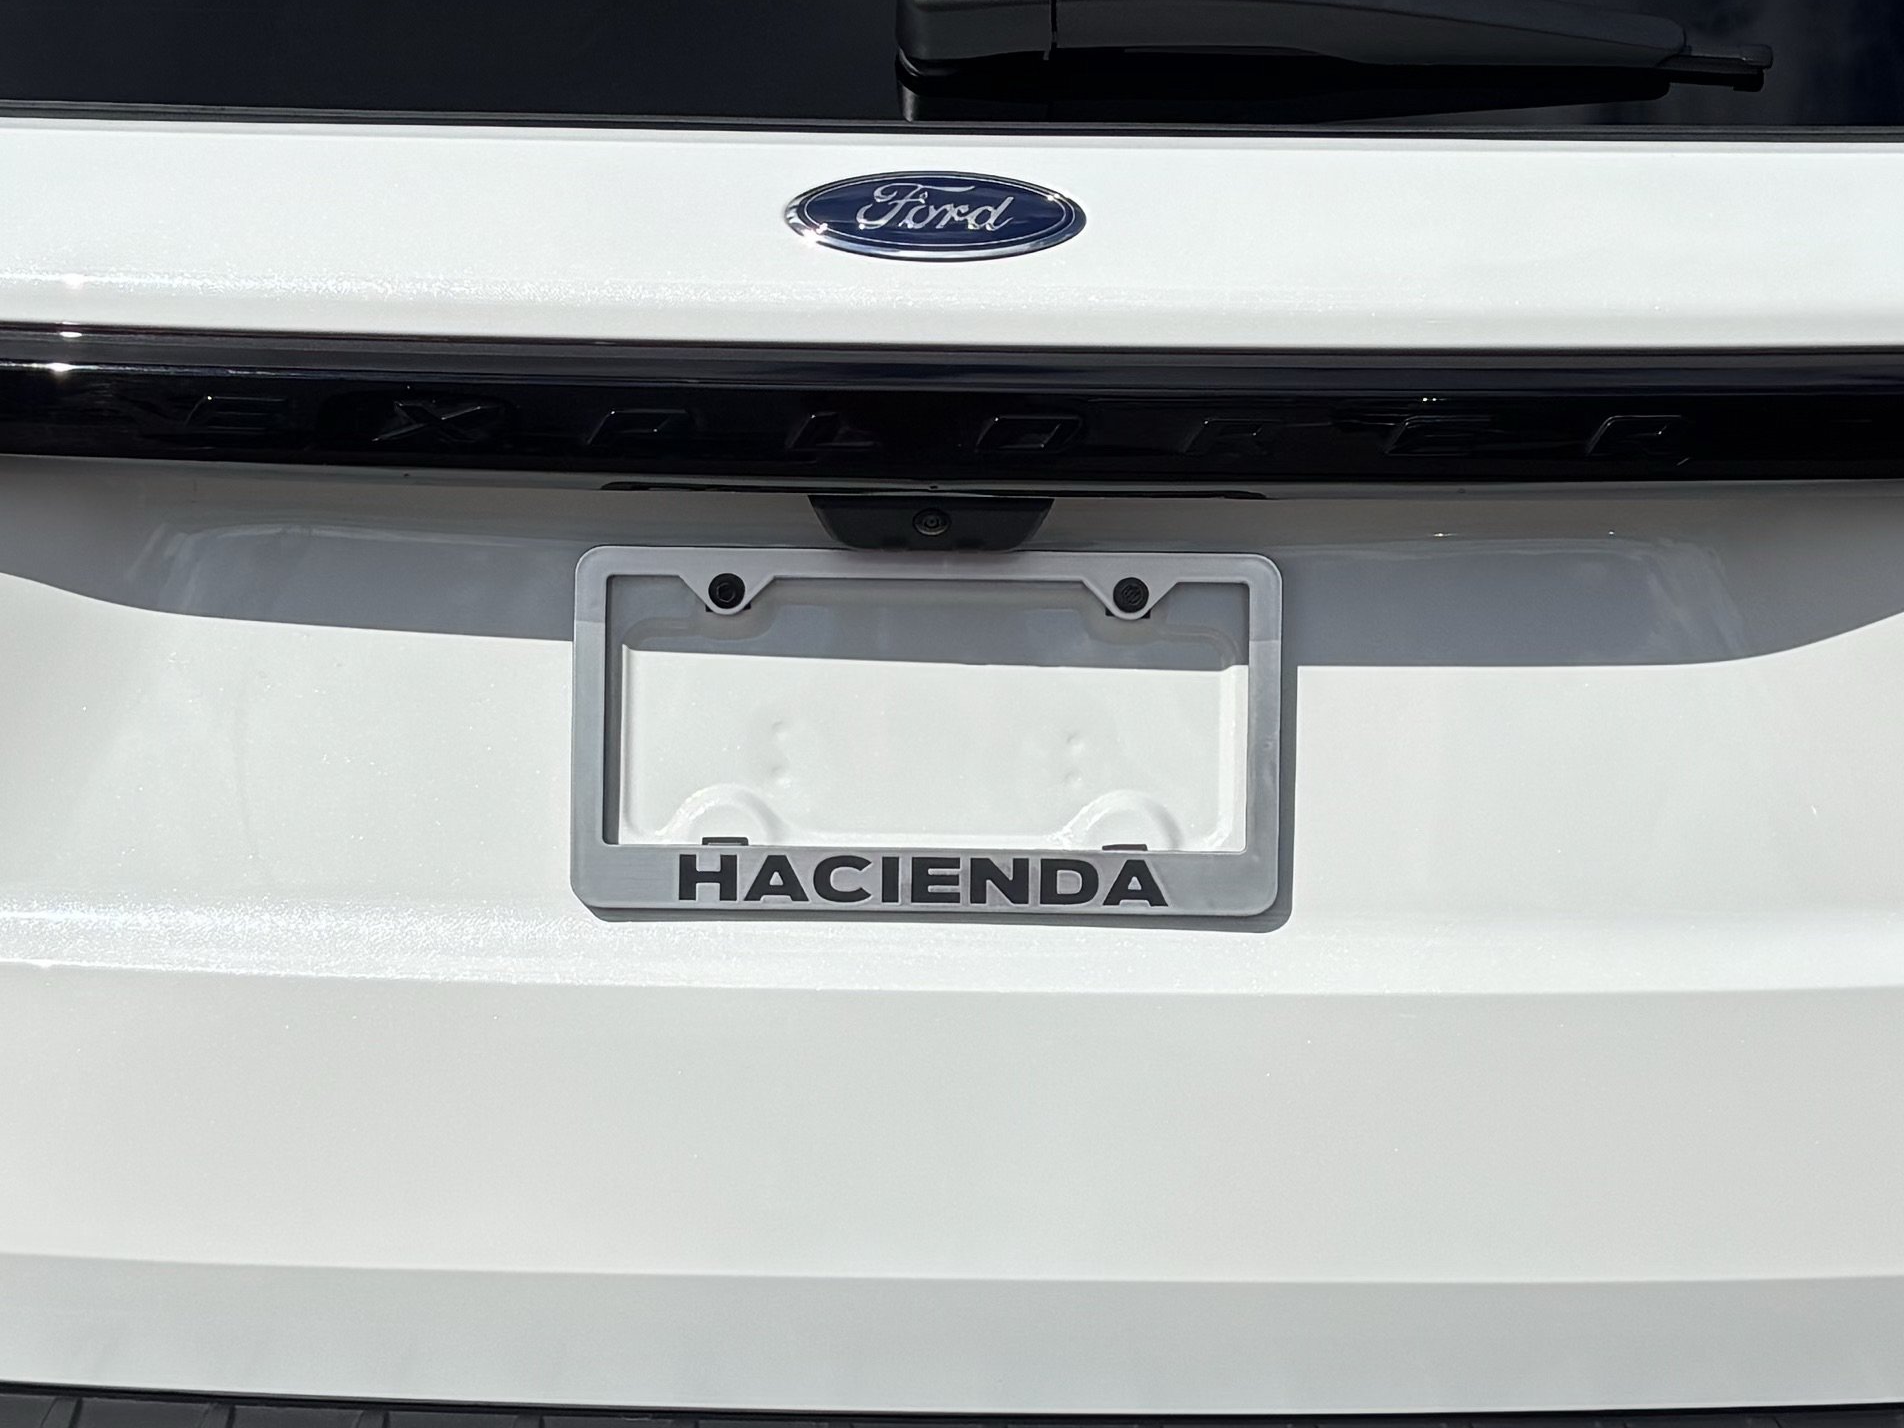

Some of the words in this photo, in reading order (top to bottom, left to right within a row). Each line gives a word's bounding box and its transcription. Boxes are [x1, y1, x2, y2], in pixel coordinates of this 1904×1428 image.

[856, 182, 1014, 231] Ford
[181, 392, 1693, 460] EXPLORER
[677, 854, 1170, 908] HACIENDA
